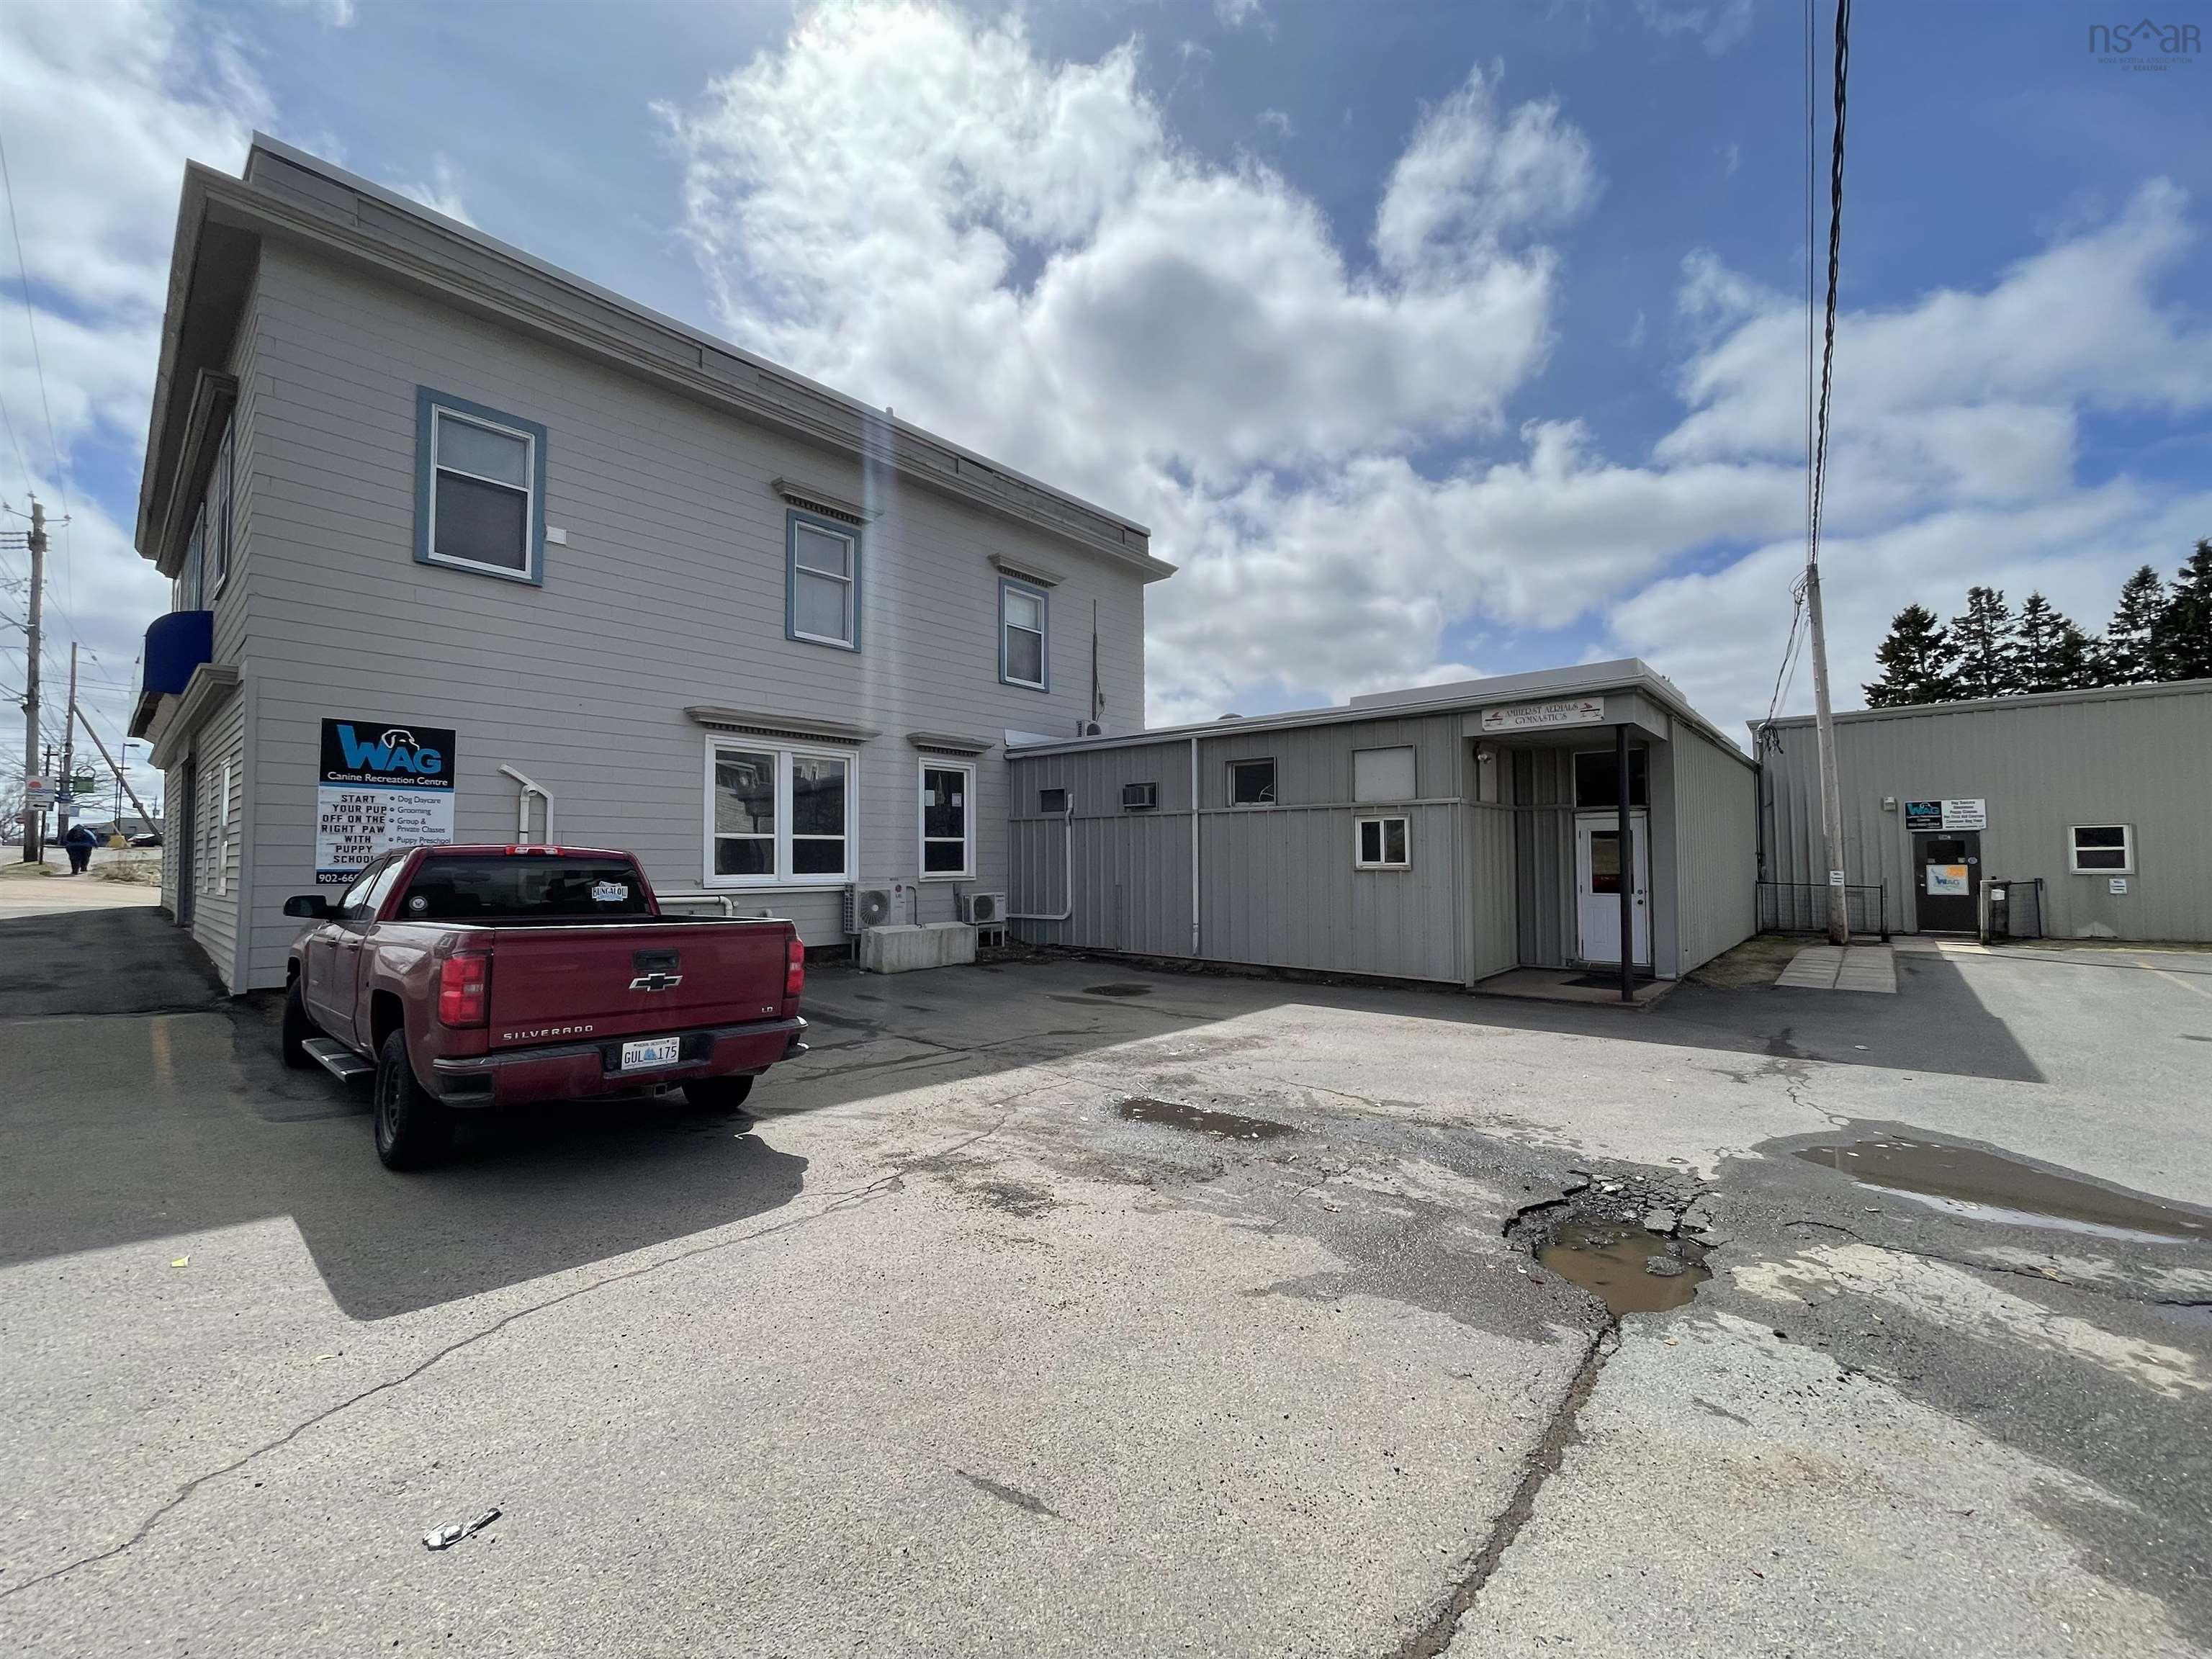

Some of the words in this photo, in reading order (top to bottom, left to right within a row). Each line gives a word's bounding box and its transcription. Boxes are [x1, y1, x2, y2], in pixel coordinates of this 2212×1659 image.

[1505, 706, 1541, 717] AMHERST
[1515, 713, 1568, 724] GYMNASTICS
[337, 724, 441, 774] WAG
[328, 771, 362, 781] Canine
[365, 773, 415, 784] Recreation
[417, 777, 448, 786] Centre
[341, 794, 376, 803] START
[397, 795, 413, 804] Dog
[333, 804, 361, 812] YOUR
[366, 805, 387, 814] PUP
[397, 806, 432, 816] Grooming
[1907, 803, 1940, 815] WAG
[397, 817, 419, 826] Group
[321, 824, 355, 833] RIGHT
[397, 836, 417, 845] Puppy
[503, 1025, 593, 1040] SILVERADO
[624, 1050, 644, 1064] GUL
[657, 1046, 677, 1059] 175
